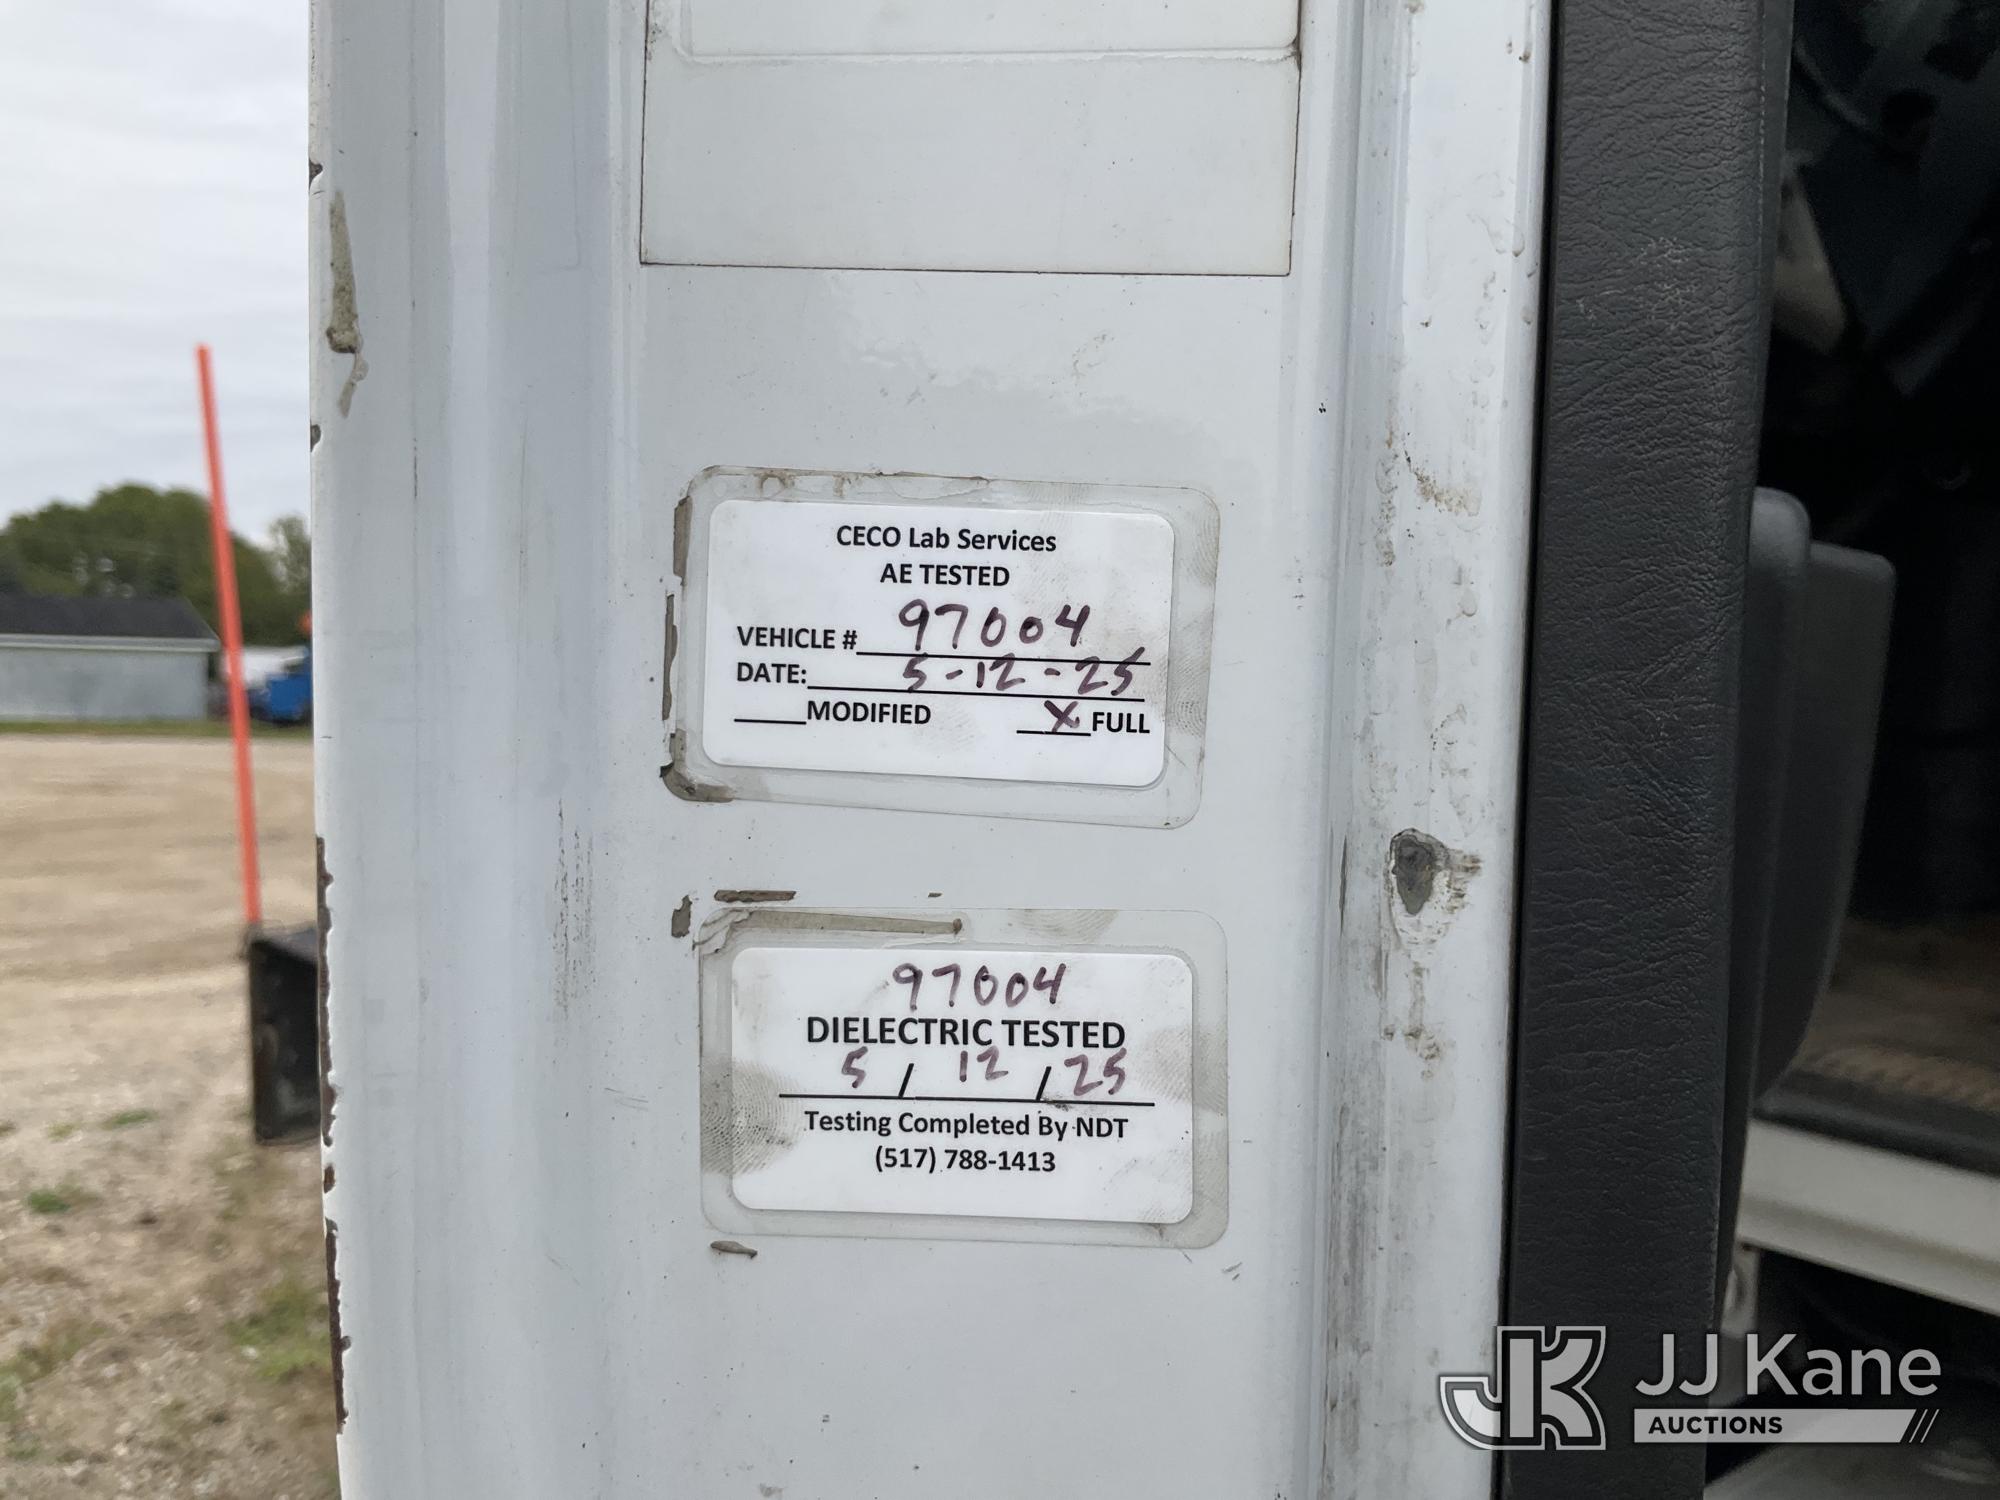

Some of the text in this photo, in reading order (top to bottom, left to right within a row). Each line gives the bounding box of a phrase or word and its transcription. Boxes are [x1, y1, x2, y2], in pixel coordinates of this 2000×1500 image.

[836, 525, 1057, 552] CECO Lab Services
[880, 563, 1010, 587] AE TESTED
[737, 598, 1091, 652] VEHICLE # 97004
[736, 662, 807, 685] DATE:
[806, 700, 932, 726] MODIFIED
[1092, 711, 1150, 734] FULL
[892, 962, 1073, 1012] 97004
[807, 1016, 1126, 1050] DIELECTRIC TESTED
[804, 1110, 1129, 1142] Testing Completed By NDT
[874, 1147, 1056, 1175] (517) 788-1413
